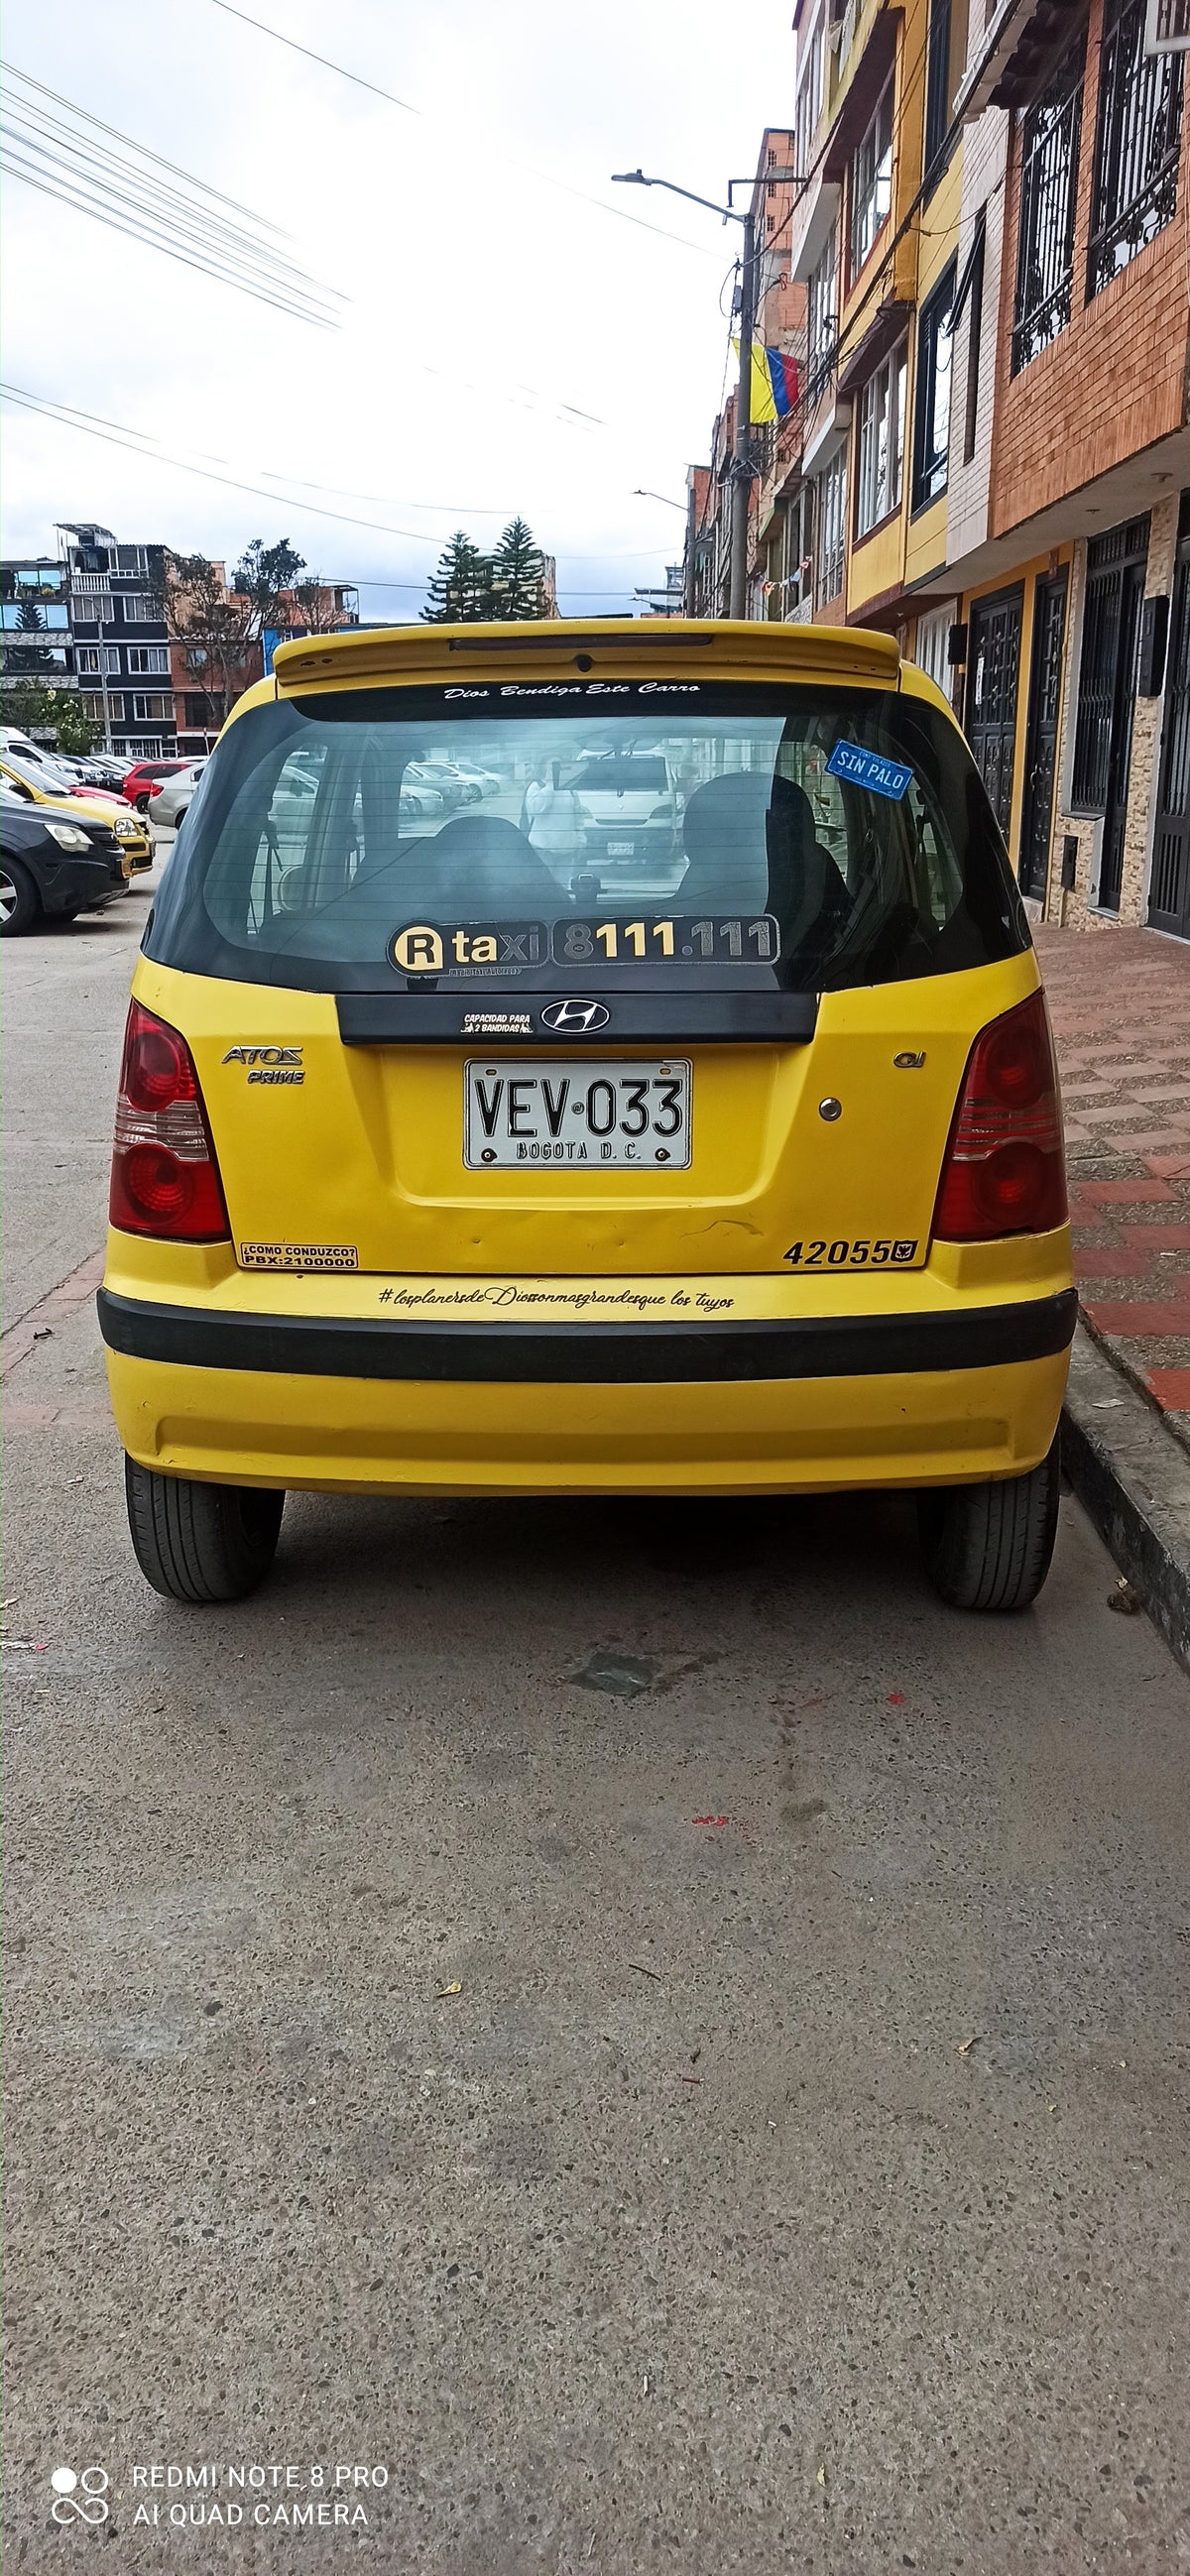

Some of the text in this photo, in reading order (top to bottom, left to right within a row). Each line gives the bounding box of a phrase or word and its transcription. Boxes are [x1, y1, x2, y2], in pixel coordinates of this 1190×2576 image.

[444, 682, 701, 700] Dios Bendiga Este Carro
[837, 751, 867, 774] SIN
[866, 763, 904, 789] PALO
[563, 921, 773, 961] 8111.111
[464, 1013, 531, 1023] CAPACIDAD PARA
[474, 1023, 521, 1033] 2 BANDIDAS
[247, 1070, 305, 1085] PRIME
[516, 1141, 588, 1160] BOGOTA
[244, 1245, 355, 1257] ¿COMO CONDUZCO?
[782, 1239, 892, 1265] 42055
[245, 1255, 355, 1267] PBX:2100000
[670, 1290, 692, 1306] los
[695, 1293, 735, 1312] tuyos
